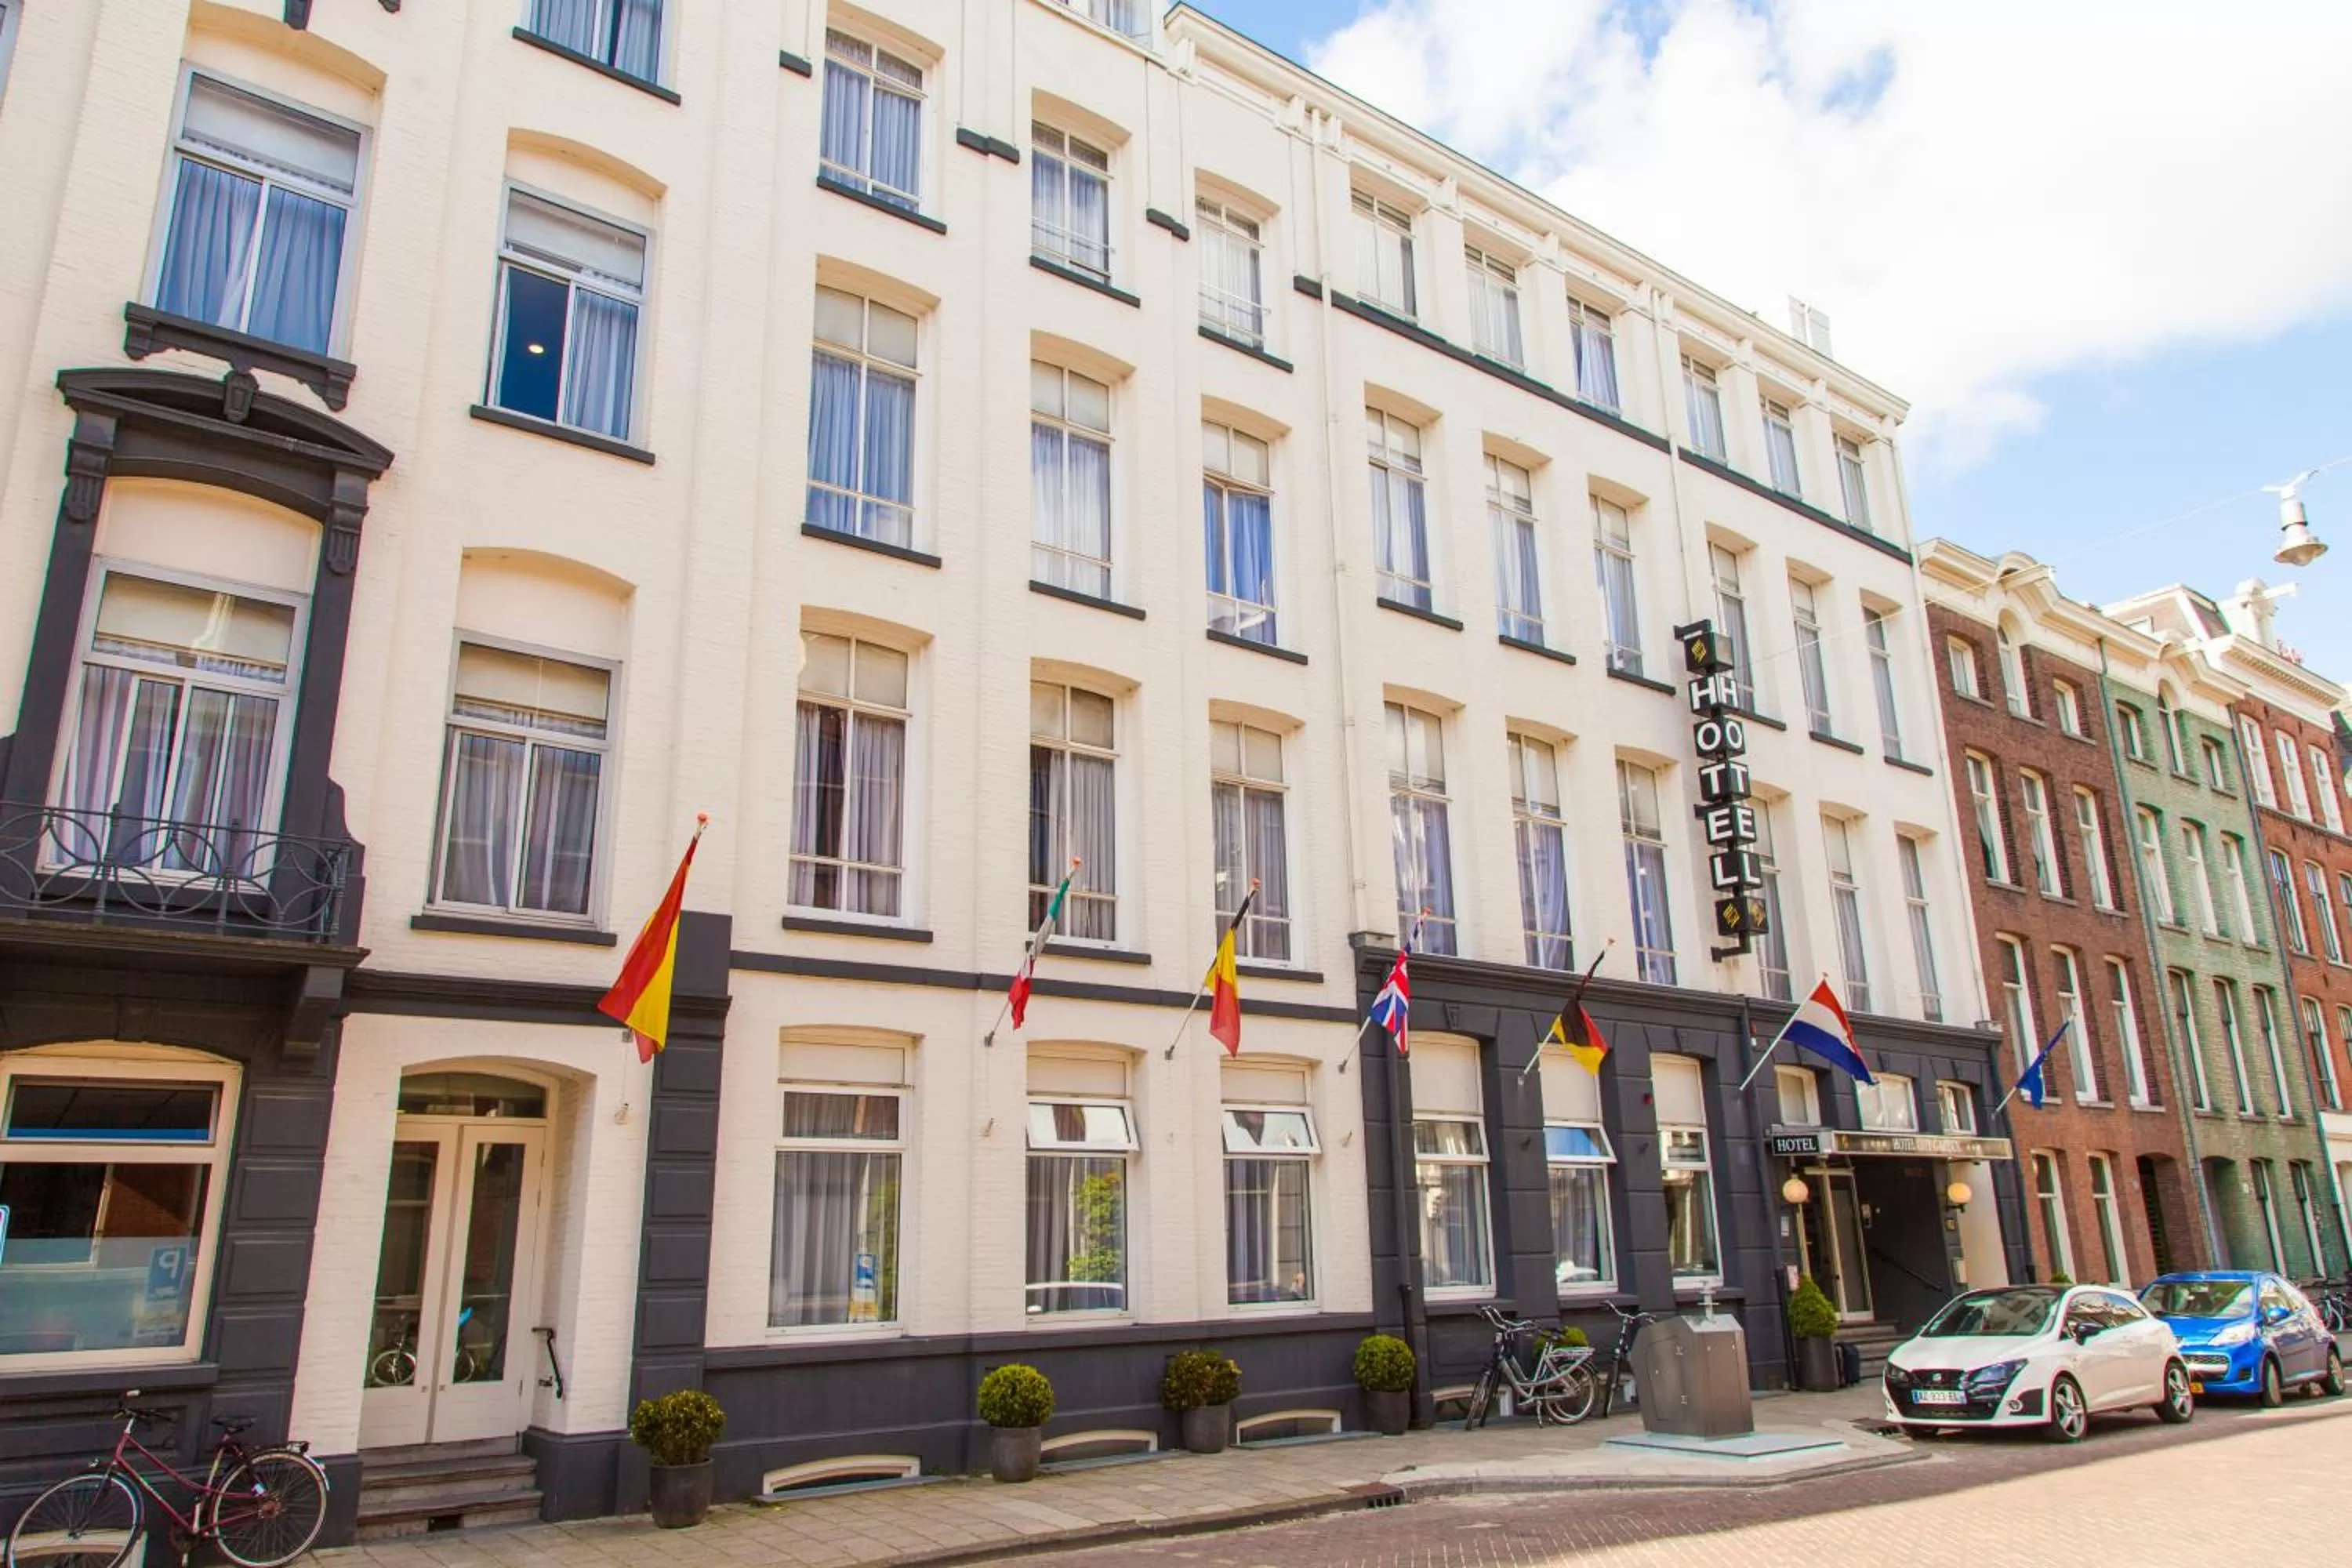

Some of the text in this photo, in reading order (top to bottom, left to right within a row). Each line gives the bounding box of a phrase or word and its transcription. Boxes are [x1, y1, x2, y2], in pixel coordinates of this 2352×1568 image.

[1693, 677, 1738, 887] HOTEL
[1719, 676, 1761, 885] HOTEL
[1777, 1138, 1817, 1152] HOTEL
